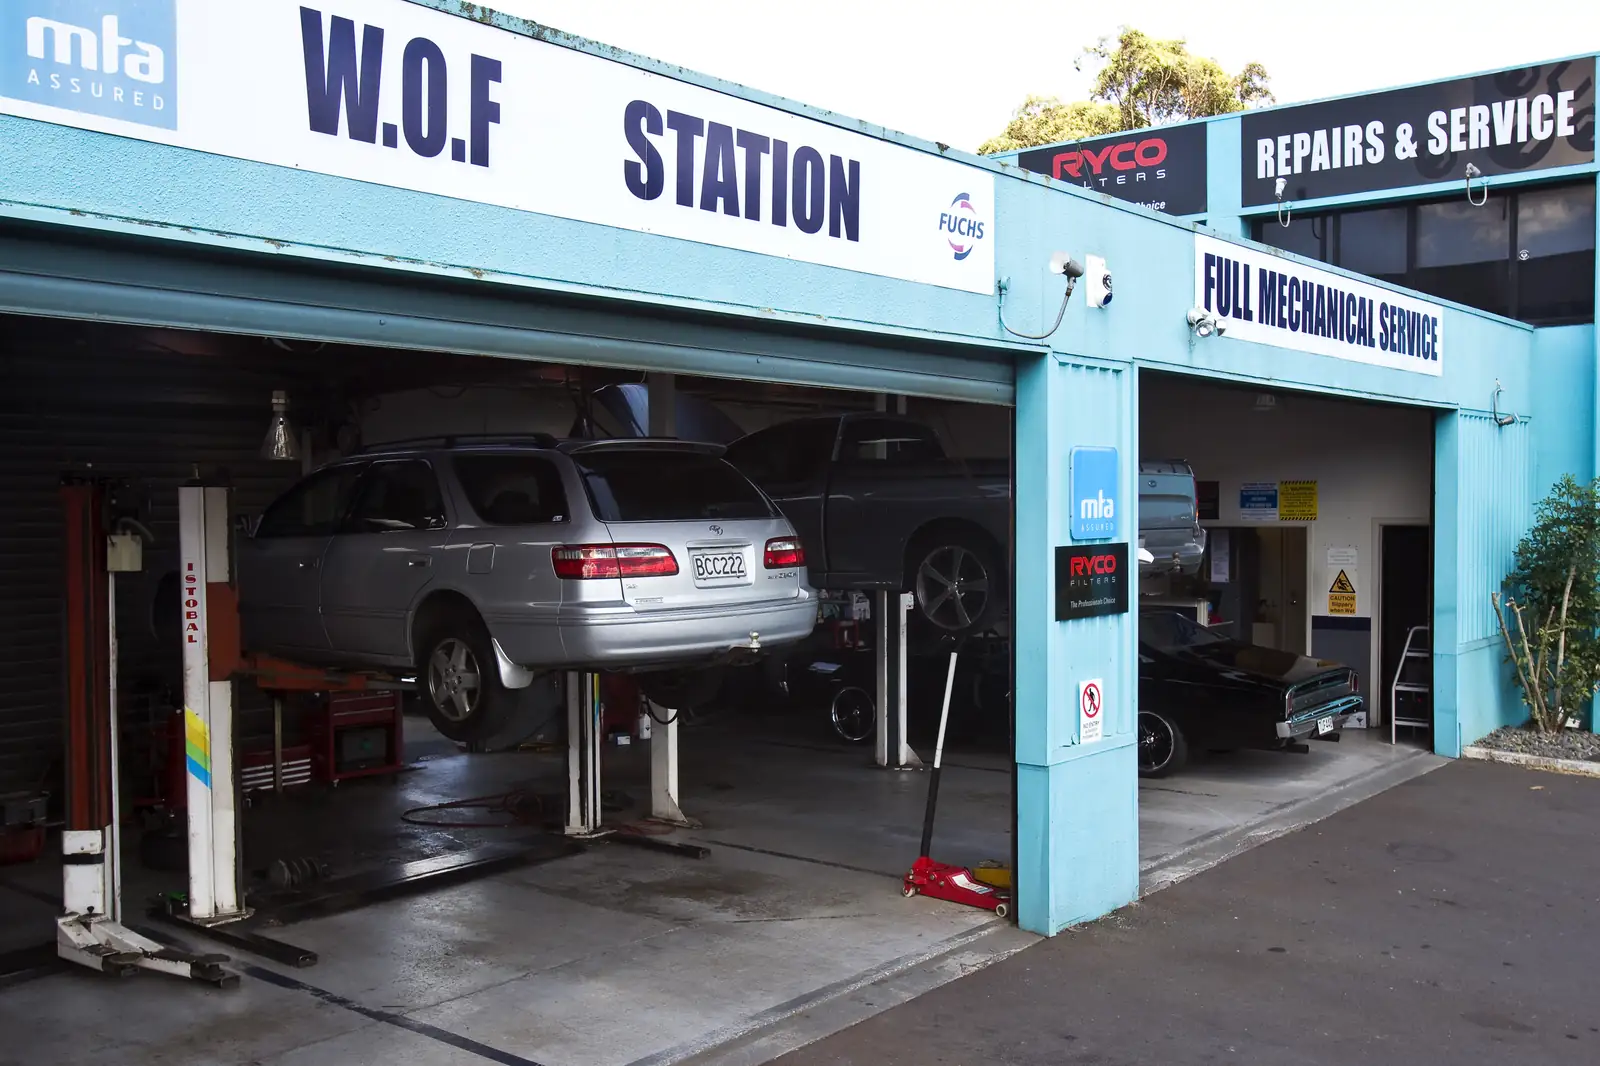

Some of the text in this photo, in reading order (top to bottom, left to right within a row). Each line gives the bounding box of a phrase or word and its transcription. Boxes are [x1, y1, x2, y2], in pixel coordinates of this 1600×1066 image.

[27, 14, 164, 84] mta
[27, 73, 165, 111] ASSURED
[299, 6, 861, 243] W.O.F STATION
[1256, 90, 1575, 179] REPAIRS & SERVICE
[1052, 138, 1168, 180] RYCO
[1083, 169, 1166, 189] LTERS
[939, 212, 985, 240] FUCHS
[1204, 252, 1438, 361] FULL MECHANICAL SERVICE
[1080, 489, 1114, 519] mta
[1081, 522, 1114, 532] ASSURED
[696, 555, 745, 577] BCC222
[1070, 555, 1116, 577] RYCO
[1070, 576, 1116, 587] FILTERS
[185, 562, 198, 643] ISTOBAL
[1070, 600, 1078, 609] The
[1103, 597, 1116, 605] Choice
